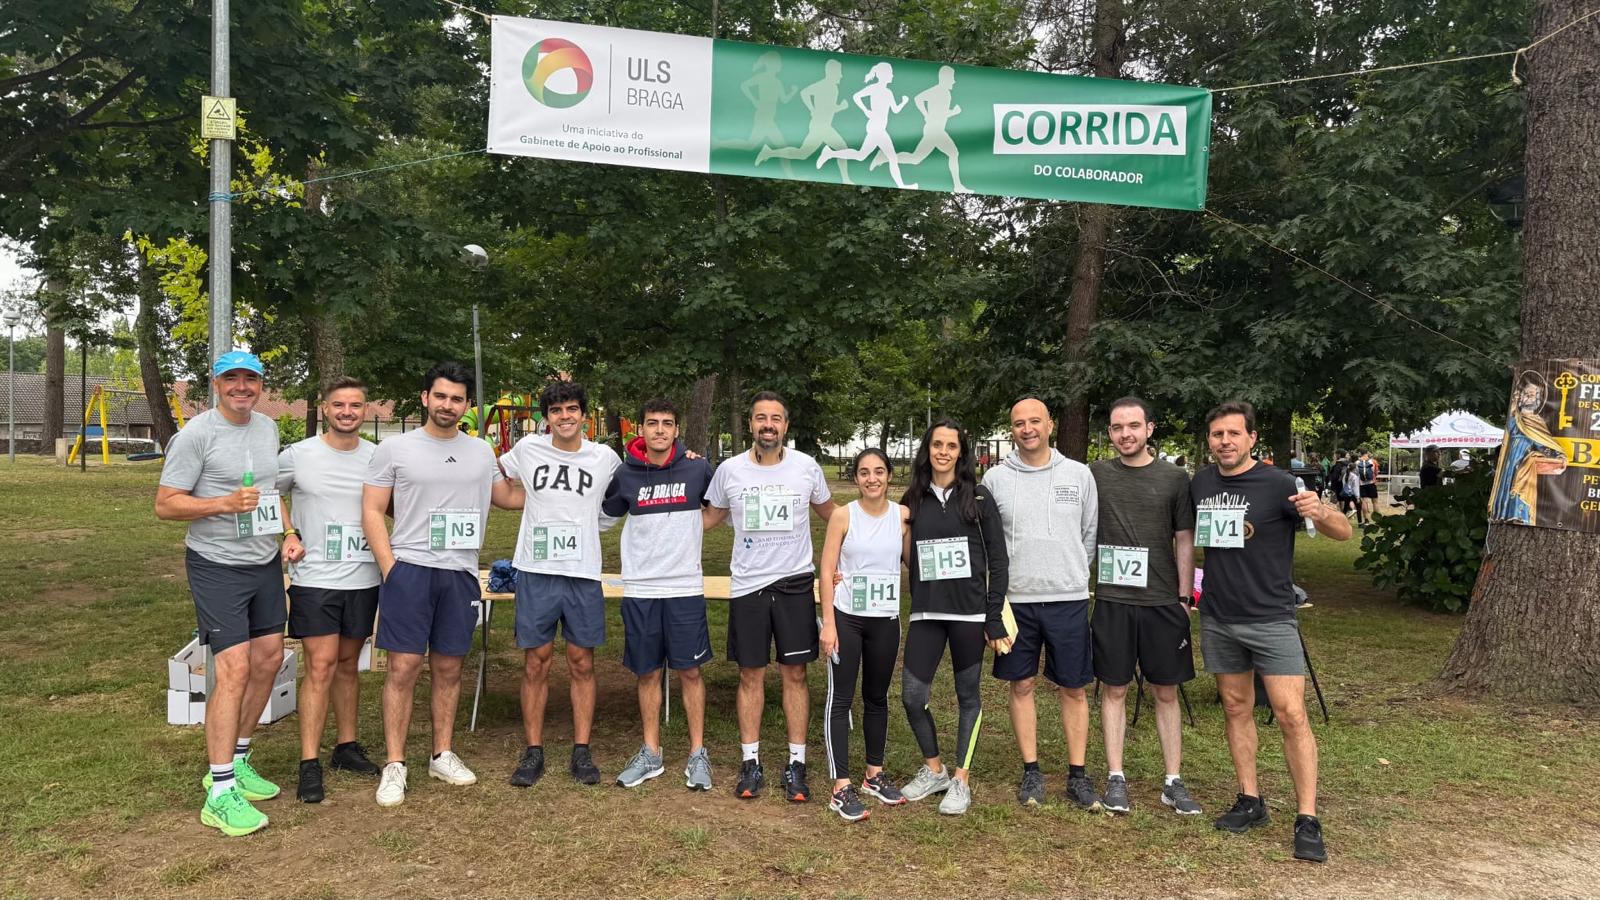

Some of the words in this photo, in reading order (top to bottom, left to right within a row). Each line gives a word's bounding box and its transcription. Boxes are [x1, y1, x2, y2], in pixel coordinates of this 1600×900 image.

[626, 56, 672, 84] ULS
[626, 87, 685, 111] BRAGA
[562, 122, 586, 136] Uma
[586, 126, 632, 140] iniciativa
[633, 130, 644, 141] do
[1001, 110, 1180, 146] CORRIDA
[519, 134, 565, 149] Gabinete
[567, 138, 580, 150] de
[581, 139, 611, 154] Apoio
[612, 144, 625, 154] ao
[627, 144, 683, 160] Profissional
[1033, 164, 1052, 177] DO
[1055, 165, 1144, 185] COLABORADOR
[1578, 400, 1590, 409] DE
[1569, 440, 1600, 464] B
[532, 464, 594, 497] GAP
[637, 486, 653, 501] SC
[652, 482, 686, 499] BRAGA
[257, 505, 279, 522] N1
[763, 505, 789, 521] V4
[1580, 500, 1600, 512] GE
[451, 522, 475, 537] N3
[1214, 519, 1239, 537] V1
[347, 536, 371, 551] N2
[553, 535, 577, 550] N4
[938, 550, 967, 569] H3
[1116, 559, 1142, 577] V2
[870, 583, 897, 601] H1
